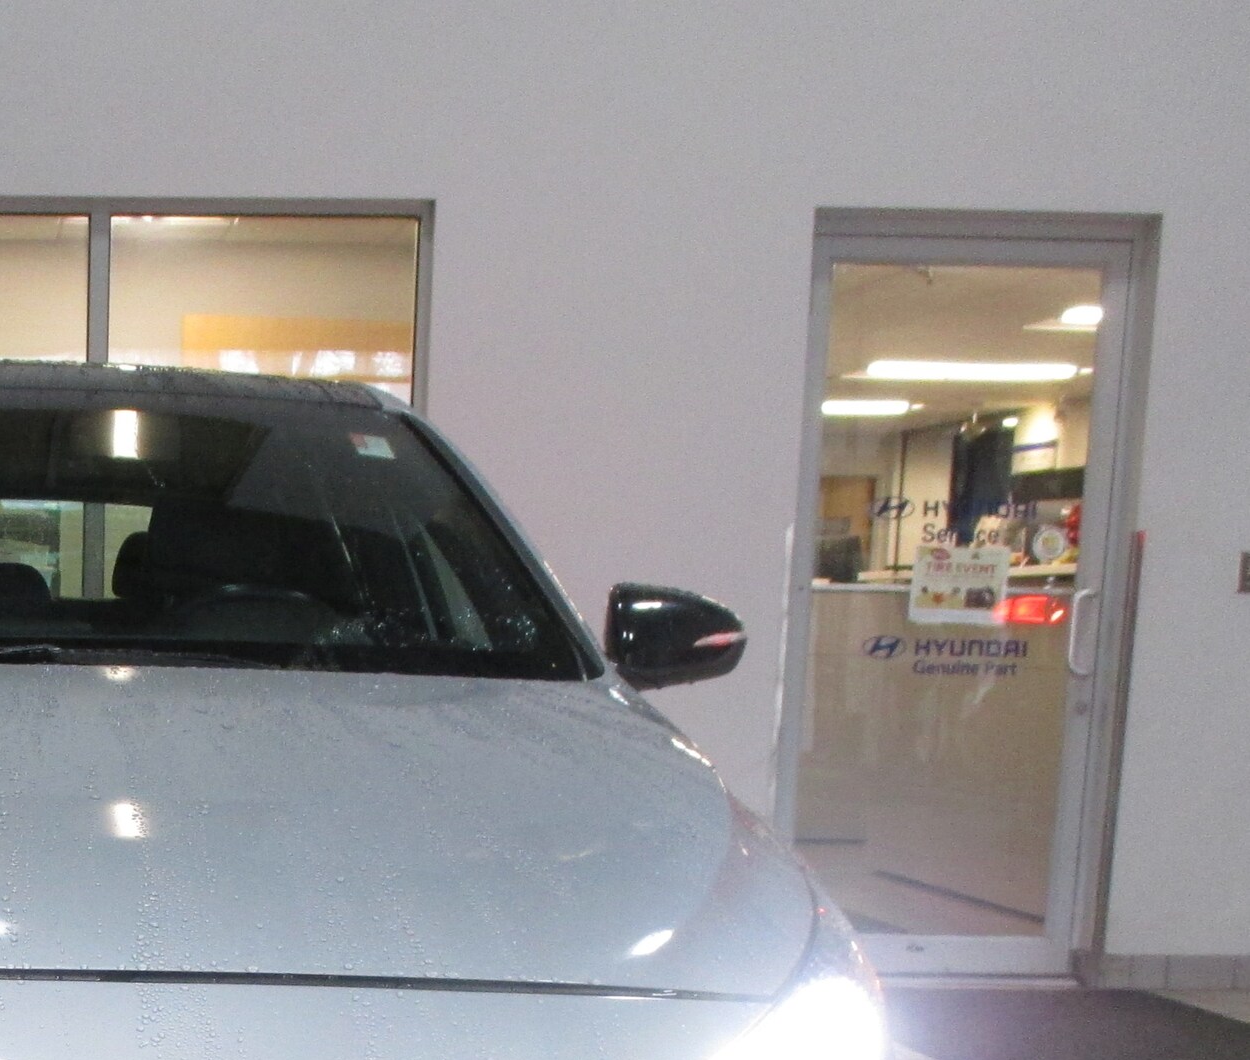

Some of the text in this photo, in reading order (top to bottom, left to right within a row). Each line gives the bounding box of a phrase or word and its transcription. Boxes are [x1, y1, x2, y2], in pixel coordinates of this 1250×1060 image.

[923, 499, 1038, 519] HYDAI
[921, 523, 1000, 545] Serce
[914, 638, 1028, 658] HYUNDAI
